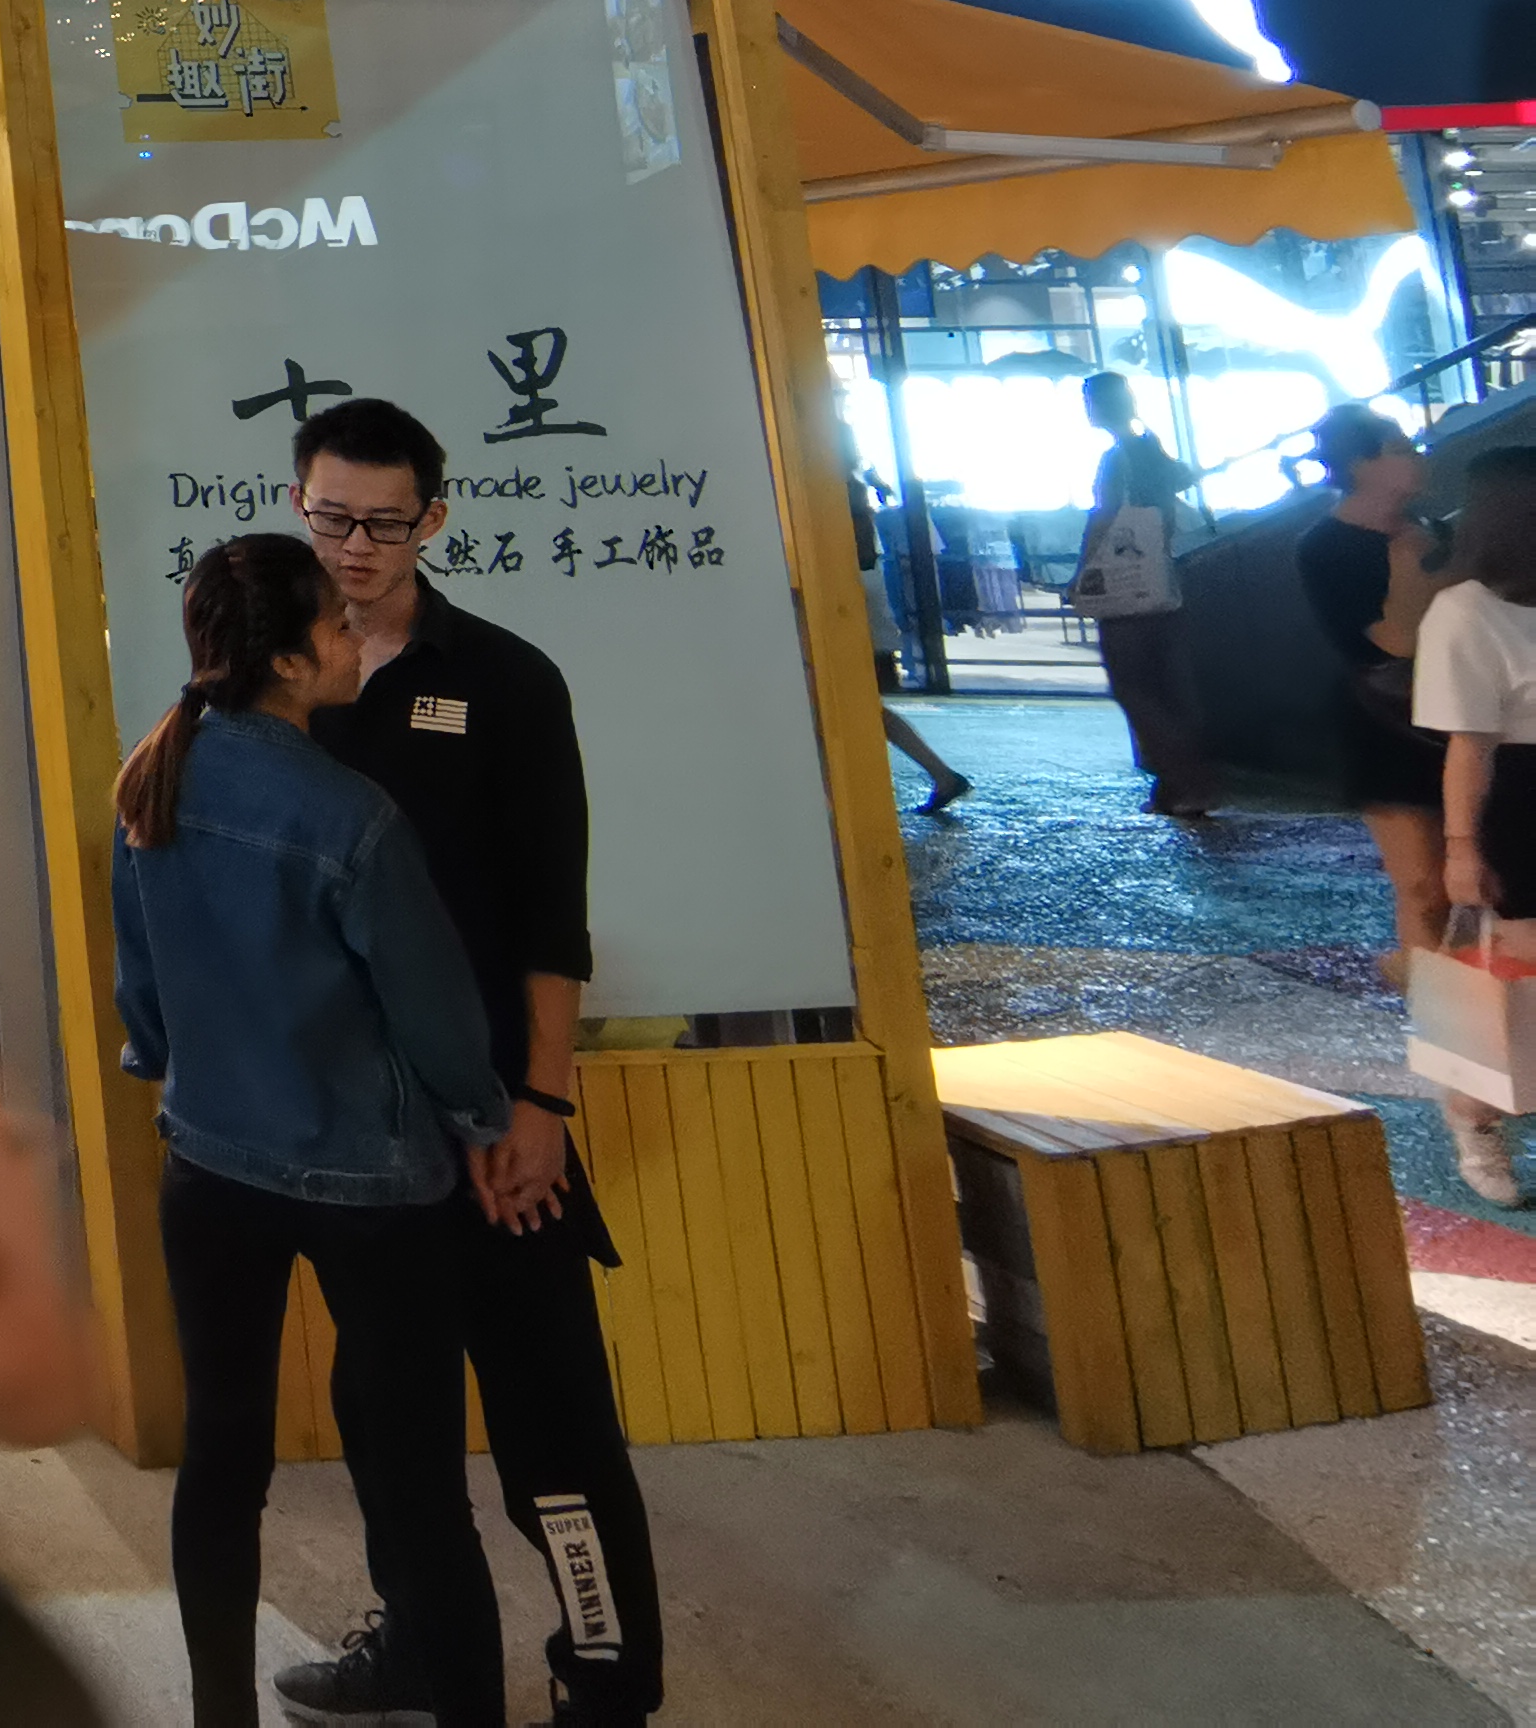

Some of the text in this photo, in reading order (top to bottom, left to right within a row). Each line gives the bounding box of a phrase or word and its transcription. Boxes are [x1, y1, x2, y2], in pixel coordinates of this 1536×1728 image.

[559, 459, 709, 509] jewelry
[545, 1516, 593, 1536] SUPER
[562, 1538, 608, 1640] WINNER
